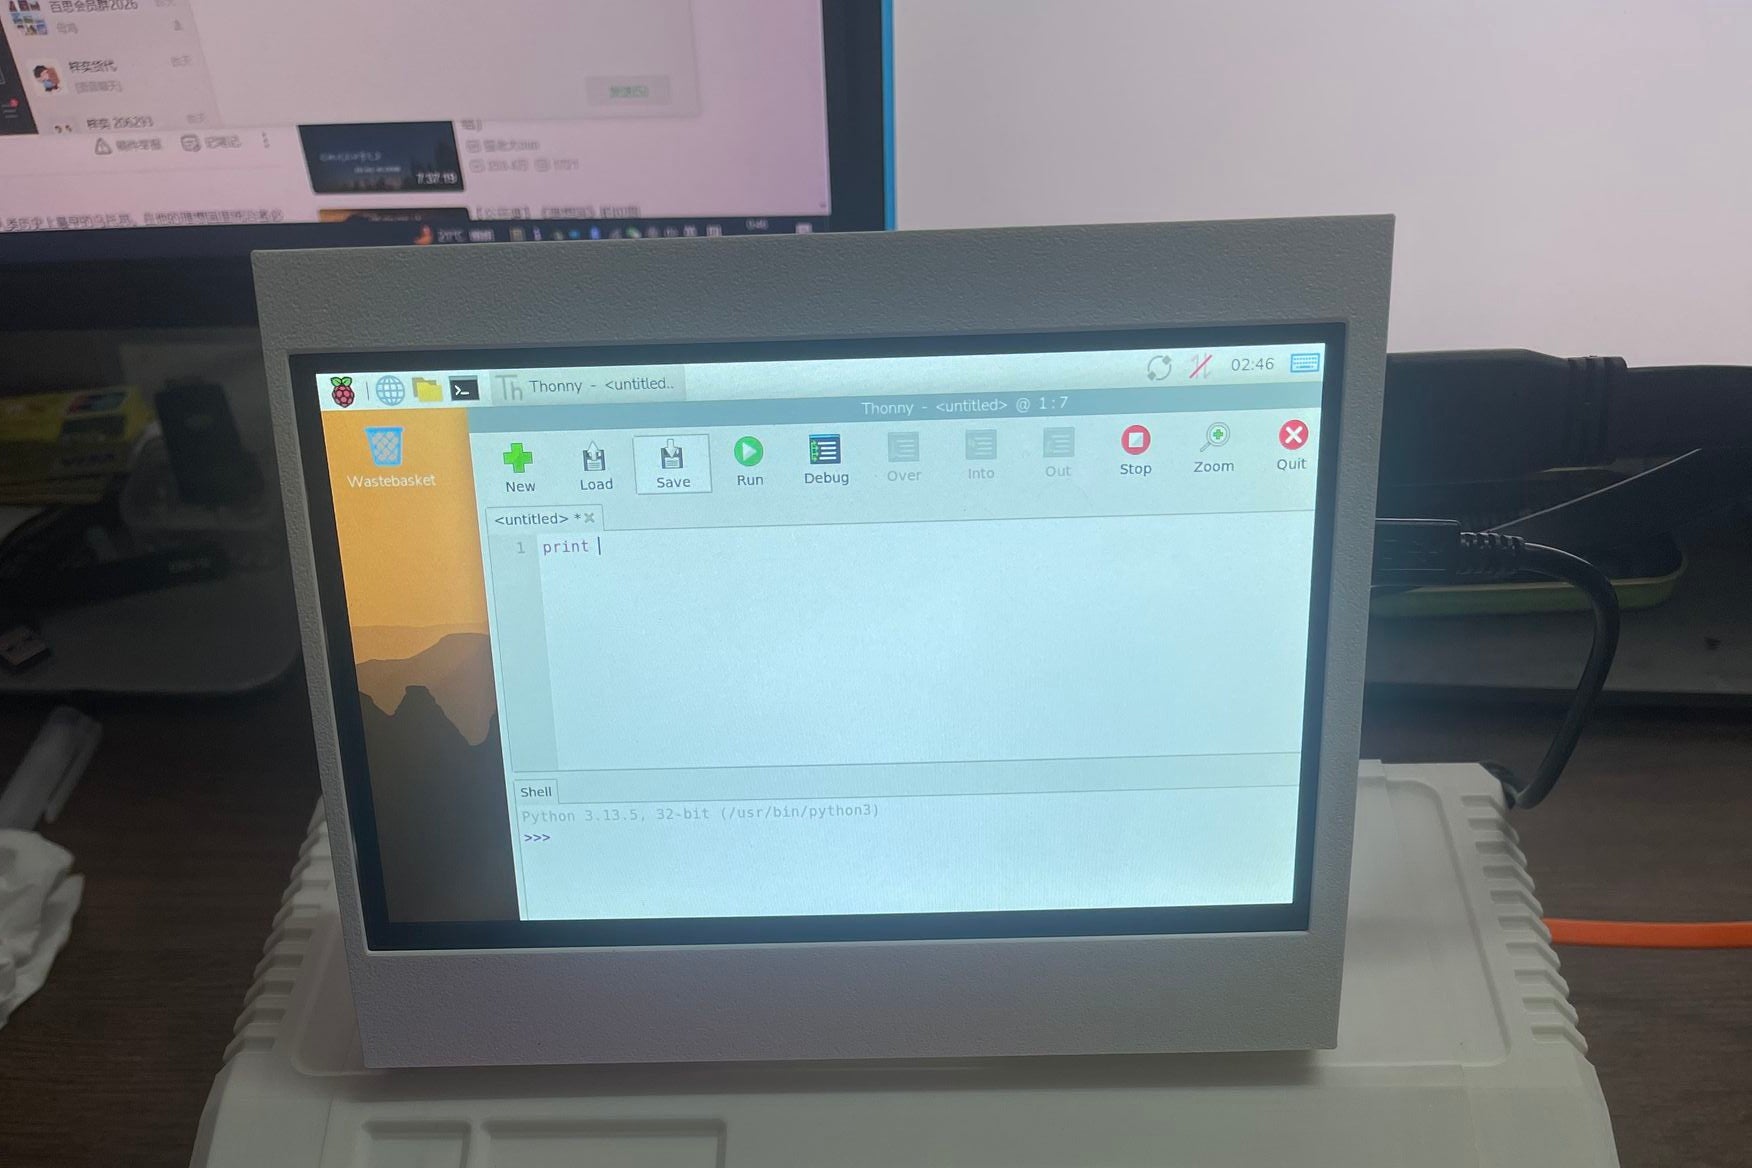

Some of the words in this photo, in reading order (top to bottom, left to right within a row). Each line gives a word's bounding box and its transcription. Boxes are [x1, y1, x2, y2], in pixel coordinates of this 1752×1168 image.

[1232, 358, 1274, 372] 02:46
[529, 379, 582, 394] Thonny
[861, 402, 914, 417] Thonny
[936, 399, 1007, 413] <untitled>
[1016, 398, 1030, 413] @
[1039, 396, 1068, 410] 1:7
[1046, 465, 1071, 477] Out
[1120, 462, 1152, 477] Stop
[1194, 460, 1234, 473] Zoom
[1277, 458, 1307, 473] Quit
[737, 474, 763, 486] Run
[805, 472, 849, 486] Debug
[887, 470, 922, 481] Over
[968, 468, 995, 480] Into
[347, 474, 436, 488] Wastebasket
[506, 481, 535, 493] New
[580, 478, 613, 491] Load
[657, 476, 690, 489] Save
[495, 512, 568, 526] <untitled>
[517, 542, 525, 554] 1
[543, 540, 589, 556] print
[521, 786, 552, 797] Shell
[522, 811, 575, 824] Python
[585, 809, 646, 822] 3.13.5,
[656, 807, 709, 820] 32-bit
[721, 804, 879, 821] (/usr/bin/python3)
